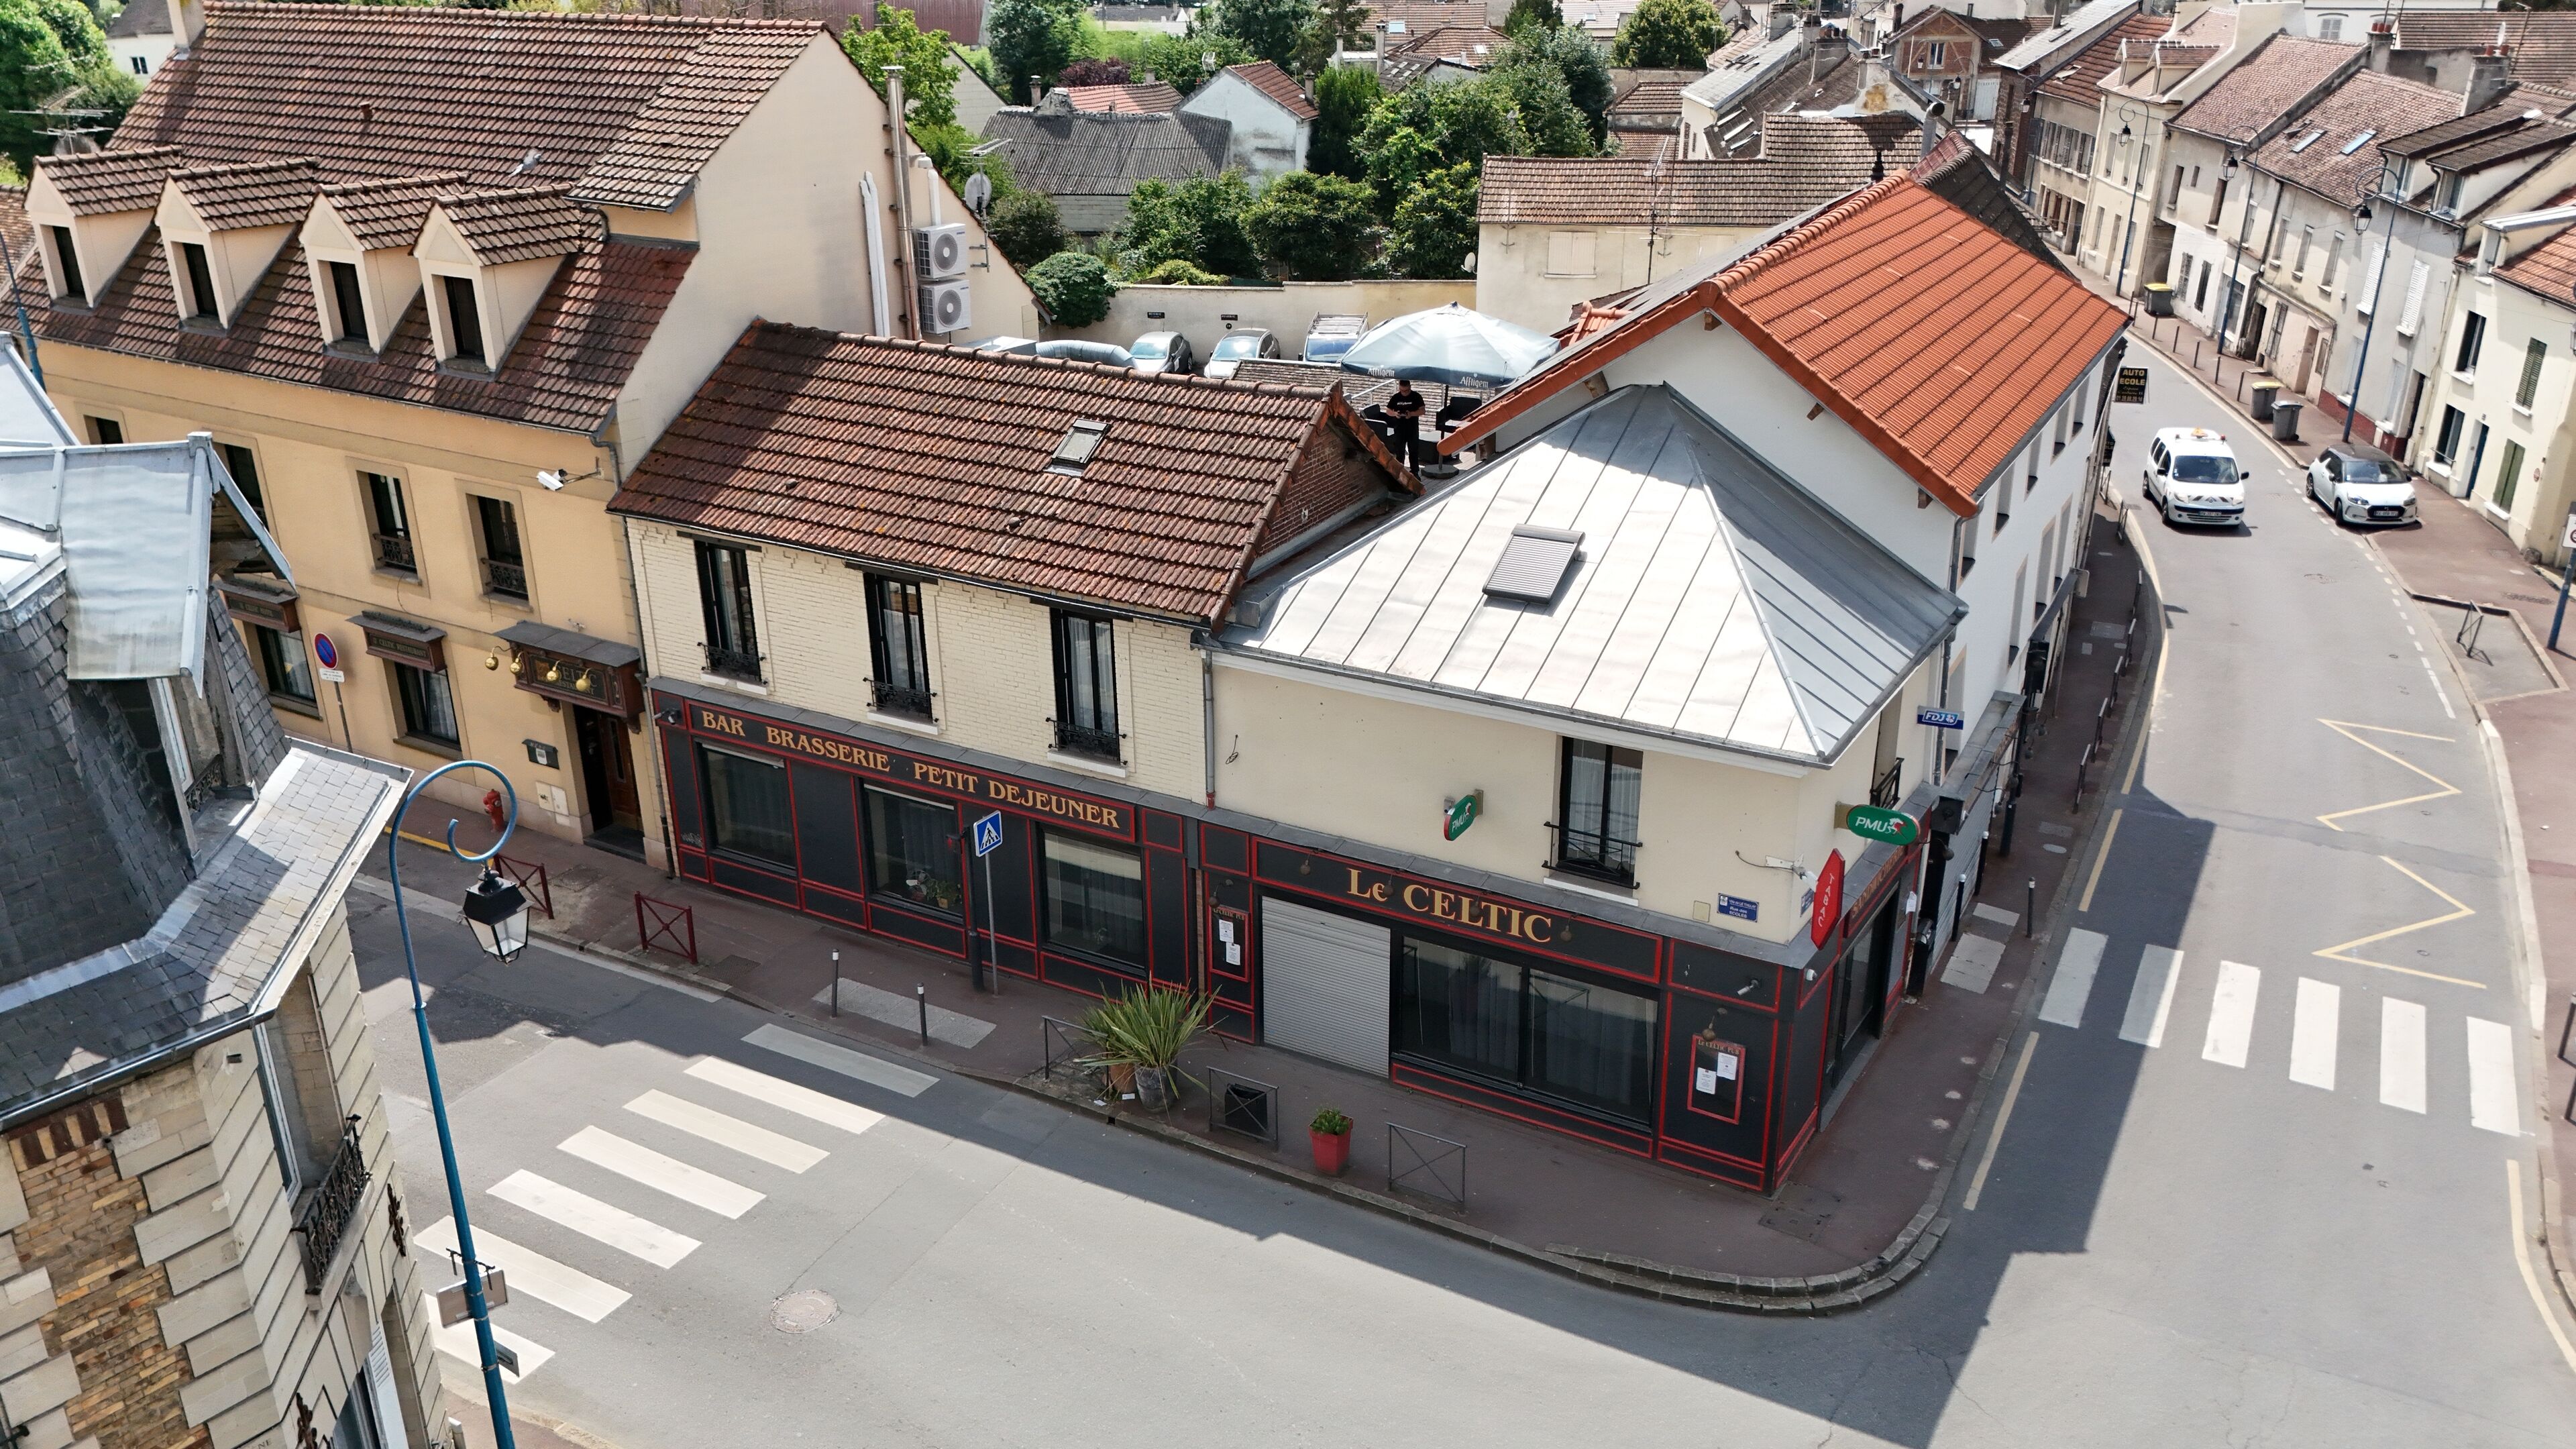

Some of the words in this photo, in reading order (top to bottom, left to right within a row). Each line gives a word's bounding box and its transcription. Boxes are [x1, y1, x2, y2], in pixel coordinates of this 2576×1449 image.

[1367, 367, 1395, 377] Affligem
[1459, 376, 1489, 388] Affligem
[1925, 712, 1945, 722] FDJ
[701, 710, 746, 737] BAR
[765, 726, 891, 772] BRASSERIE
[913, 761, 978, 793] PETIT
[987, 780, 1120, 828] DEJEUNER
[1452, 812, 1466, 833] PMU
[1855, 816, 1888, 832] PMU
[1346, 867, 1389, 902] Le
[1403, 883, 1552, 943] CELTIC
[1818, 873, 1835, 928] TABAC
[1729, 910, 1748, 918] ECOLES
[1705, 1041, 1725, 1051] CELTIC
[1727, 1046, 1739, 1055] PUB
